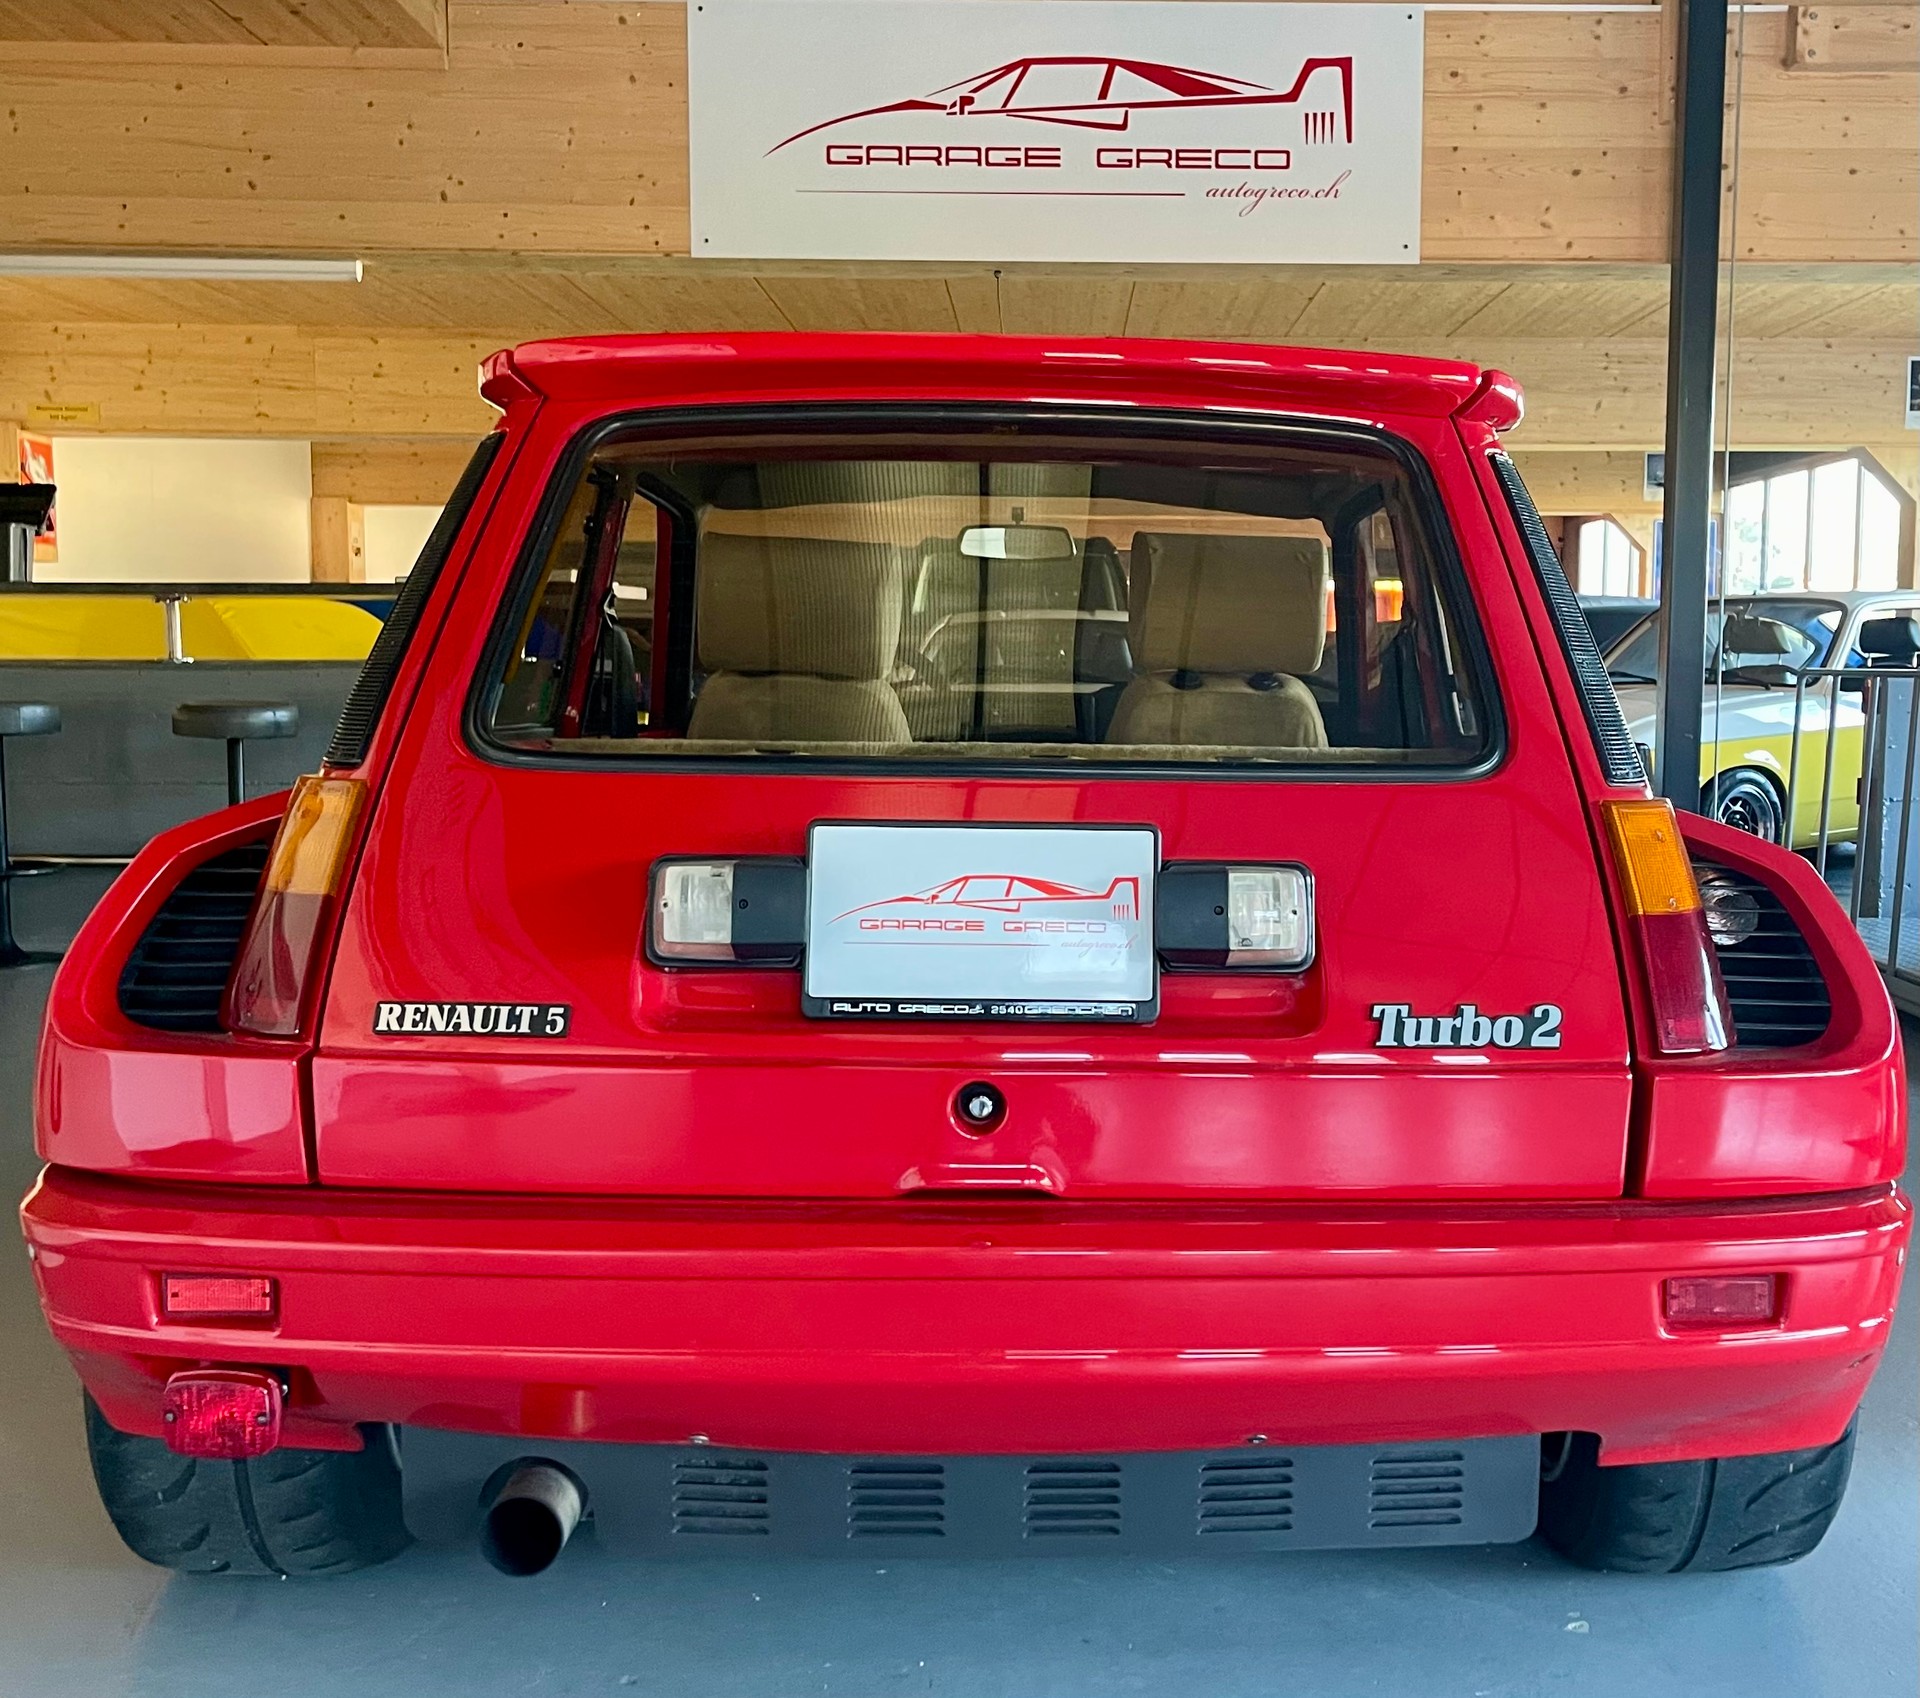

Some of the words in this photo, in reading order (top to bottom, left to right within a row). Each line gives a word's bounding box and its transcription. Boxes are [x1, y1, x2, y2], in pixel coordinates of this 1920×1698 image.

[826, 144, 1061, 168] GARAGE
[1096, 148, 1291, 170] GRECO
[1205, 169, 1352, 217] autogreco.ch
[859, 918, 985, 932] GARAGE
[1003, 920, 1107, 933] GRECO
[375, 1003, 539, 1033] RENAULT
[545, 1007, 565, 1034] 5
[833, 1002, 891, 1012] AUTO
[898, 1004, 969, 1014] GRECO
[990, 1005, 1023, 1015] 2540
[1372, 1005, 1524, 1047] Turbo
[1530, 1004, 1562, 1048] 2
